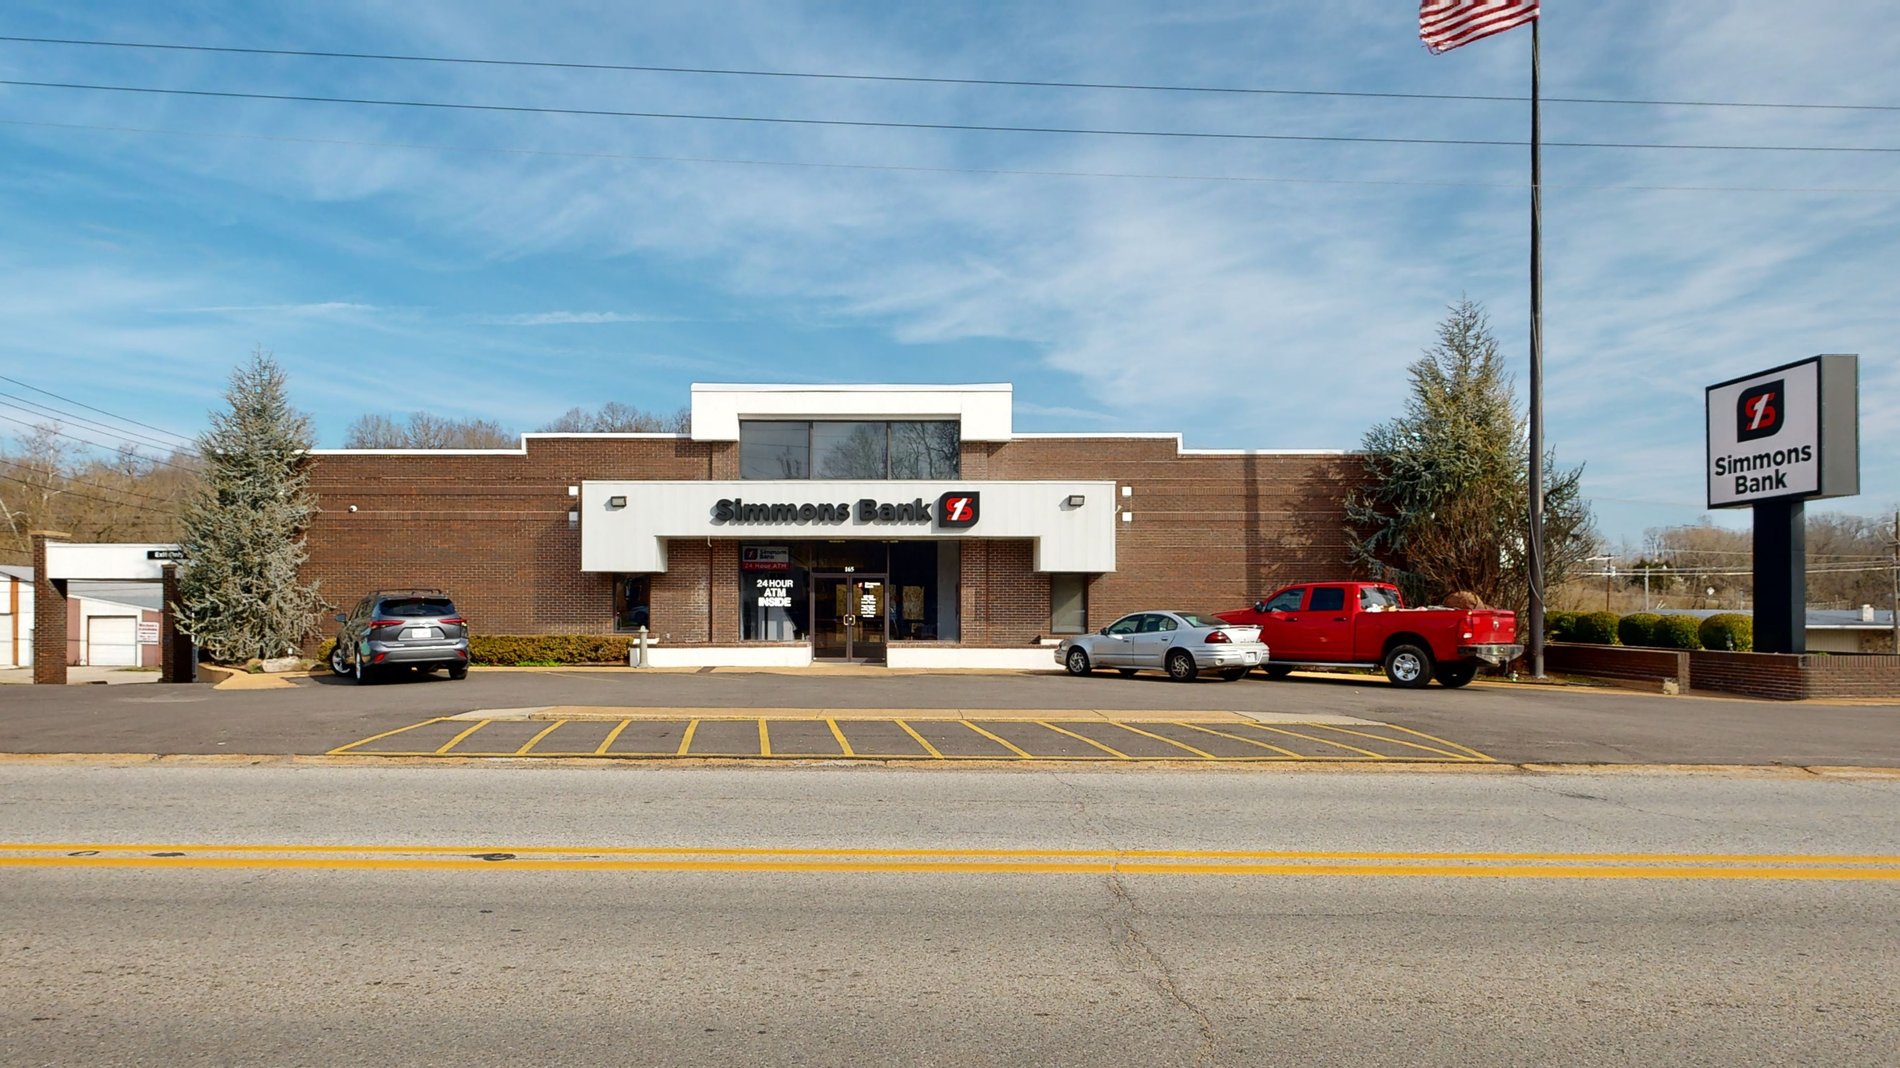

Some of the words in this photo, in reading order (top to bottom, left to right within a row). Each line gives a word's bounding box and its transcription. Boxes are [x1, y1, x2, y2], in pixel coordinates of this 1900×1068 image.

[1715, 445, 1812, 476] Simmons
[1735, 469, 1788, 495] Bank
[715, 498, 850, 522] Simmons
[859, 498, 933, 522] Bank
[756, 579, 768, 588] 24
[769, 579, 794, 588] HOUR
[763, 588, 787, 597] ATM
[758, 597, 792, 607] INSIDE
